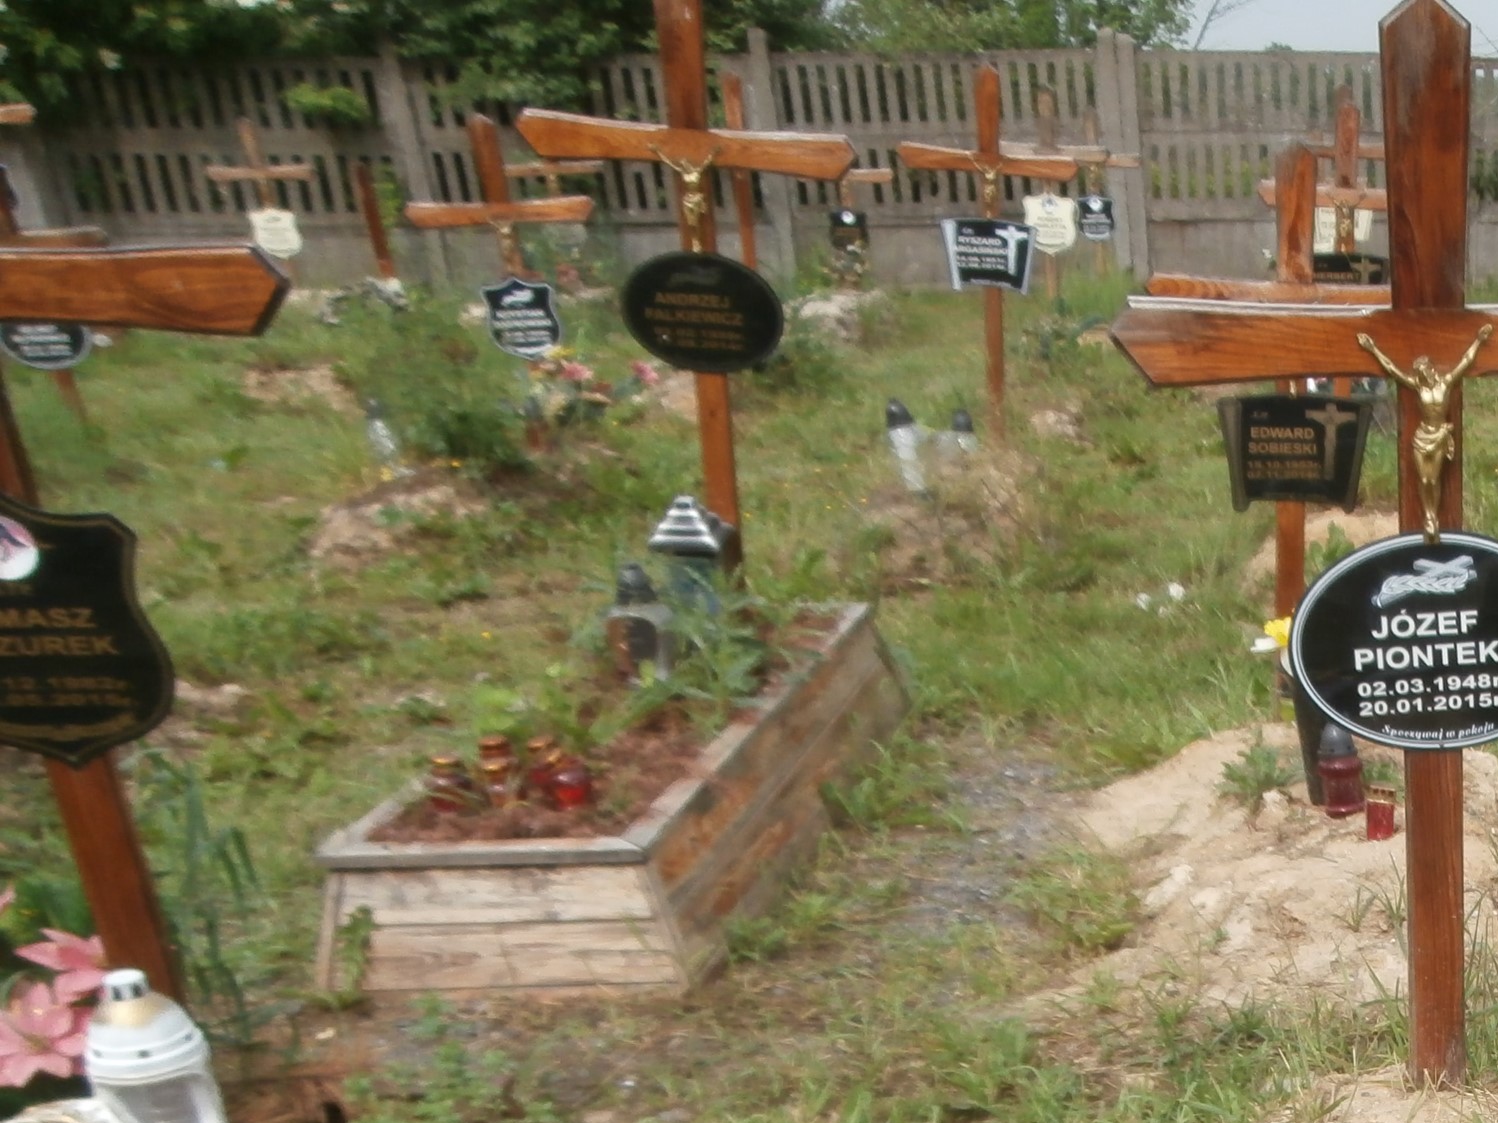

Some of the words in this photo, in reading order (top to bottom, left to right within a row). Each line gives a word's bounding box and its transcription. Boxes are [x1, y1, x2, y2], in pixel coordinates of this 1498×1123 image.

[957, 236, 1002, 246] RYSZARD
[654, 291, 731, 310] ANDRZEJ
[1250, 427, 1315, 439] EDWARD
[1248, 442, 1317, 454] SOBIESKI
[1371, 608, 1479, 640] JÓZEF
[1381, 723, 1443, 740] Spoczywaj
[1446, 730, 1455, 739] w
[1458, 721, 1495, 739] pokoju
